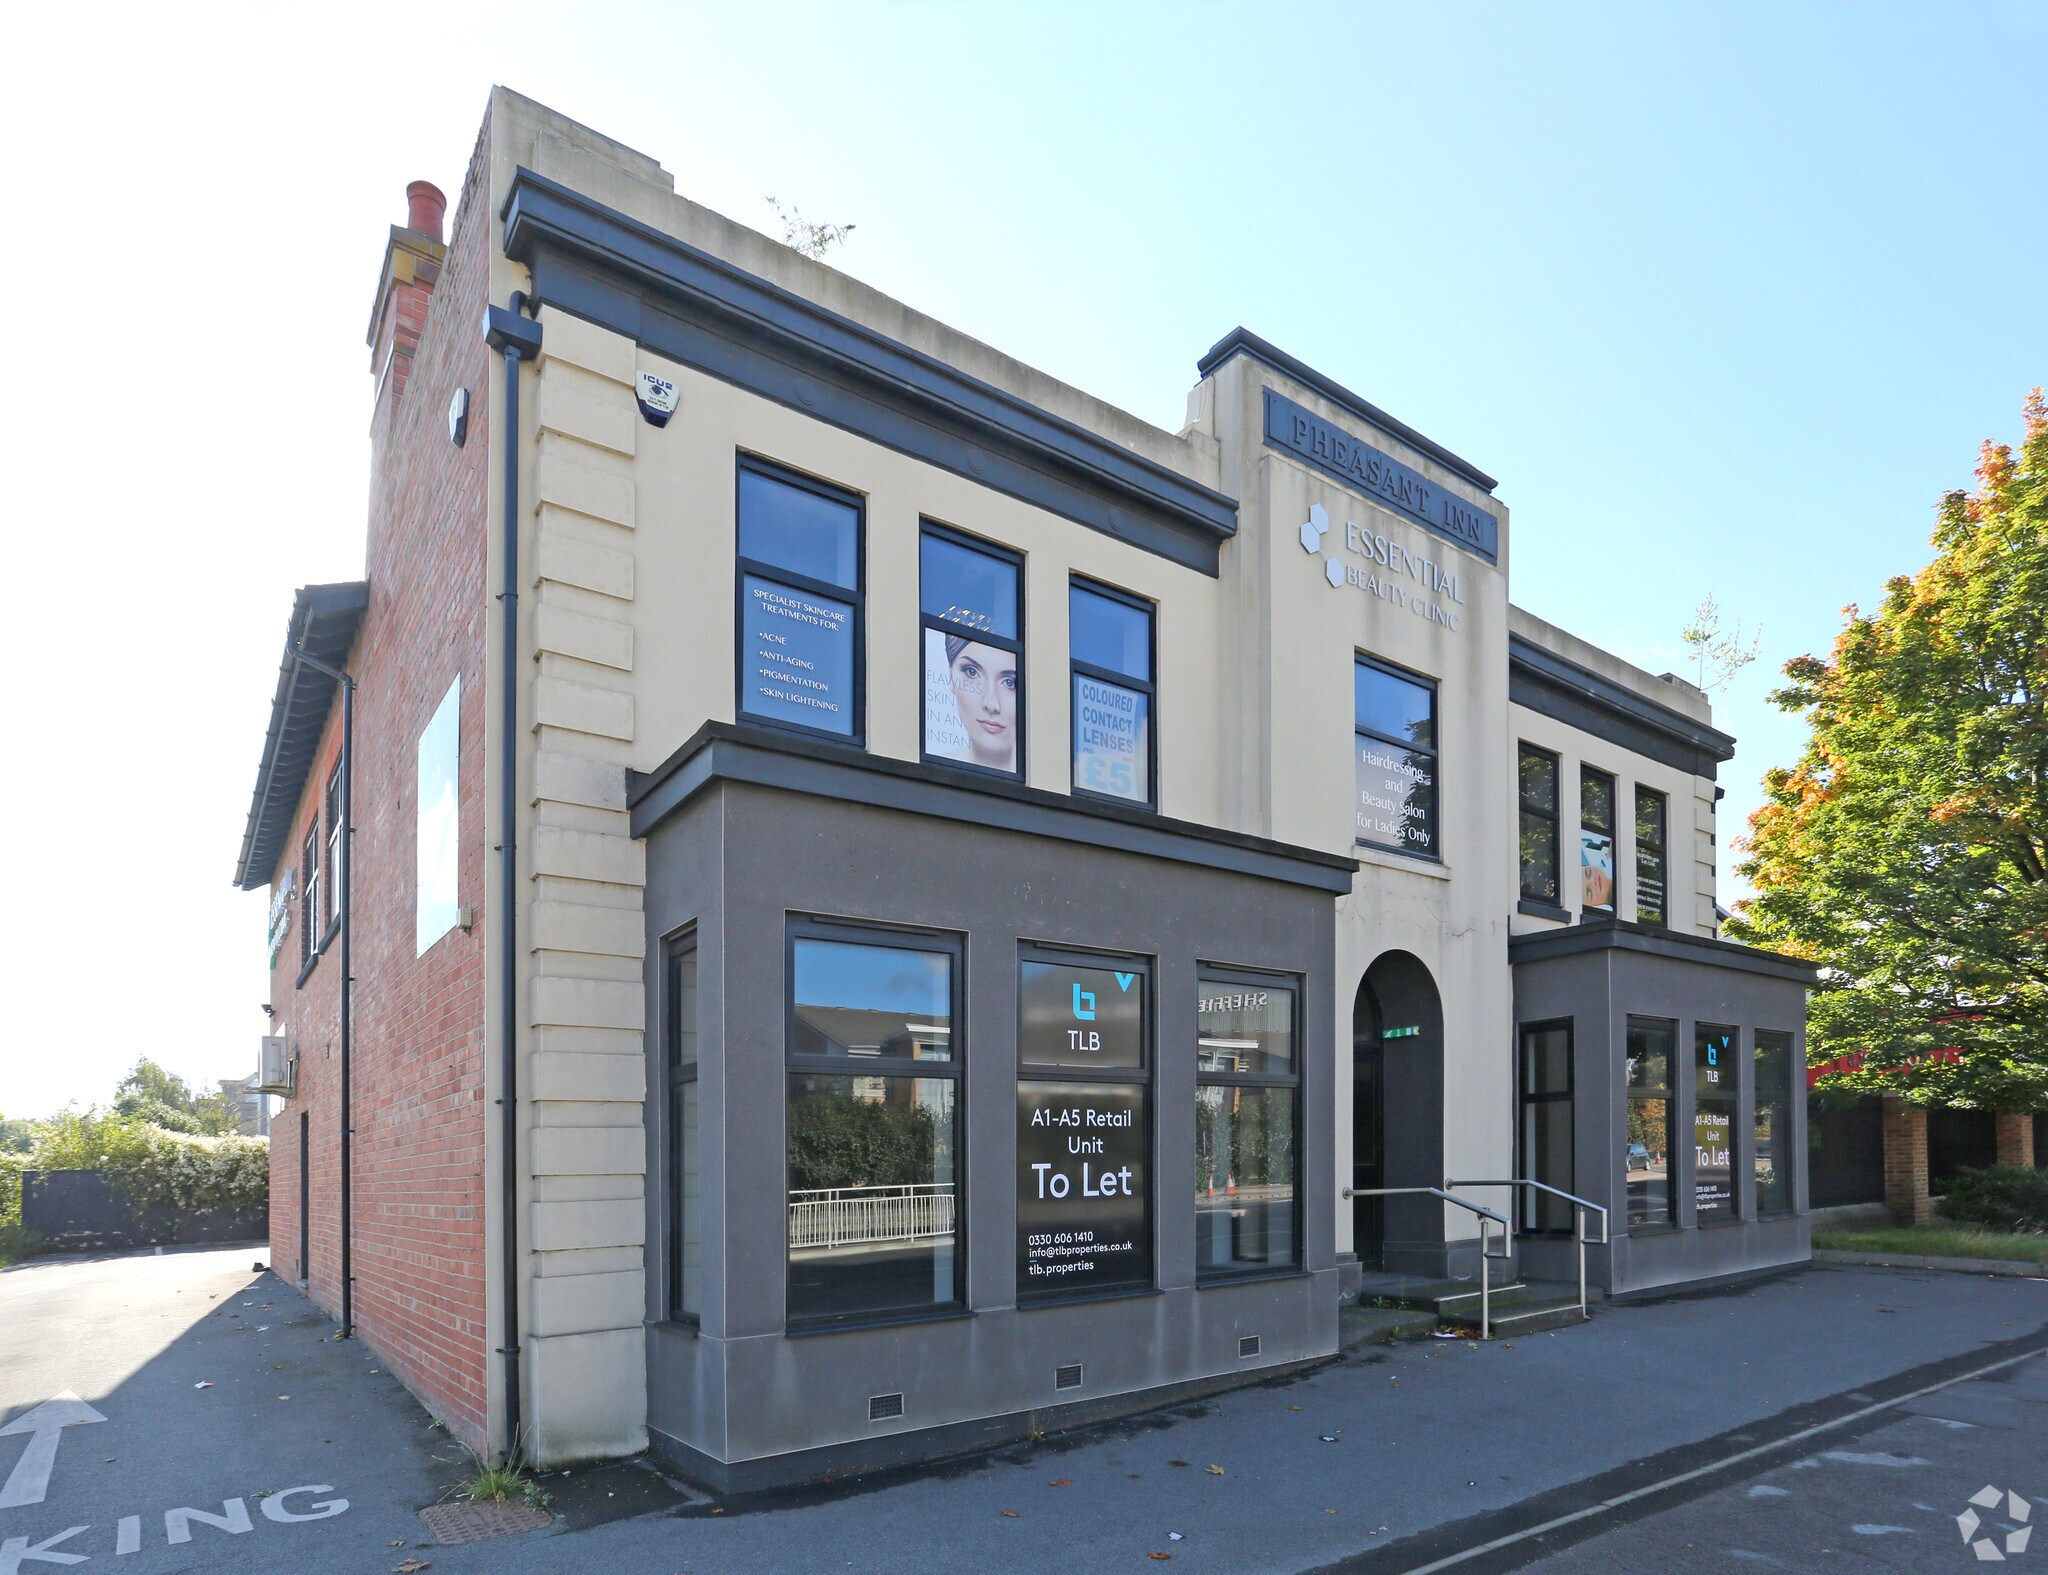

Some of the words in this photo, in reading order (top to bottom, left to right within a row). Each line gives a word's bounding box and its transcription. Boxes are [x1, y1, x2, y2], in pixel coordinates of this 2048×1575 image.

[1293, 415, 1429, 513] PHEASANT
[1444, 500, 1481, 542] INN
[1346, 520, 1466, 605] ESSENTIAL
[753, 589, 801, 608] SPECIALIST
[803, 604, 845, 622] SKINCARE
[1346, 564, 1409, 608] BEAUTY
[1411, 595, 1461, 632] CLINIC
[762, 602, 818, 625] TREATMENTS
[819, 619, 839, 631] FOR:
[762, 650, 814, 670] ANTI-AGING
[763, 668, 828, 691] PIGMENTATION
[927, 669, 983, 696] FLAWLESS
[763, 687, 784, 699] SKIN
[786, 692, 838, 712] LIGHTENING
[927, 689, 955, 707] SKIN
[1082, 684, 1133, 713] COLOURED
[927, 710, 941, 722] IN
[944, 713, 964, 729] AN
[1082, 706, 1133, 734] CONTACT
[1083, 727, 1134, 755] LENSES
[1085, 755, 1132, 794] £5
[1362, 749, 1424, 783] Hairdressing
[1384, 778, 1403, 794] and
[1362, 791, 1397, 815] Beauty
[1399, 801, 1425, 819] Salon
[1356, 811, 1373, 829] for
[1375, 818, 1406, 838] Ladies
[1408, 826, 1431, 847] Only
[1067, 1029, 1101, 1051] TLB
[1706, 1070, 1719, 1083] TLB
[1031, 1108, 1081, 1127] A1-A5
[1086, 1109, 1132, 1127] Retail
[1695, 1115, 1712, 1126] A1-A5
[1712, 1115, 1729, 1126] Retail
[1068, 1136, 1104, 1154] Unit
[1706, 1130, 1720, 1141] Unit
[1695, 1145, 1709, 1167] To
[1712, 1145, 1730, 1166] Let
[1031, 1163, 1070, 1199] To
[1083, 1162, 1132, 1197] Let
[1028, 1234, 1052, 1246] 0330
[1054, 1232, 1072, 1244] 606
[1074, 1231, 1094, 1242] 1410
[1029, 1240, 1133, 1258] info@tlbproperties.co.uk
[1028, 1260, 1094, 1276] tlb.properties
